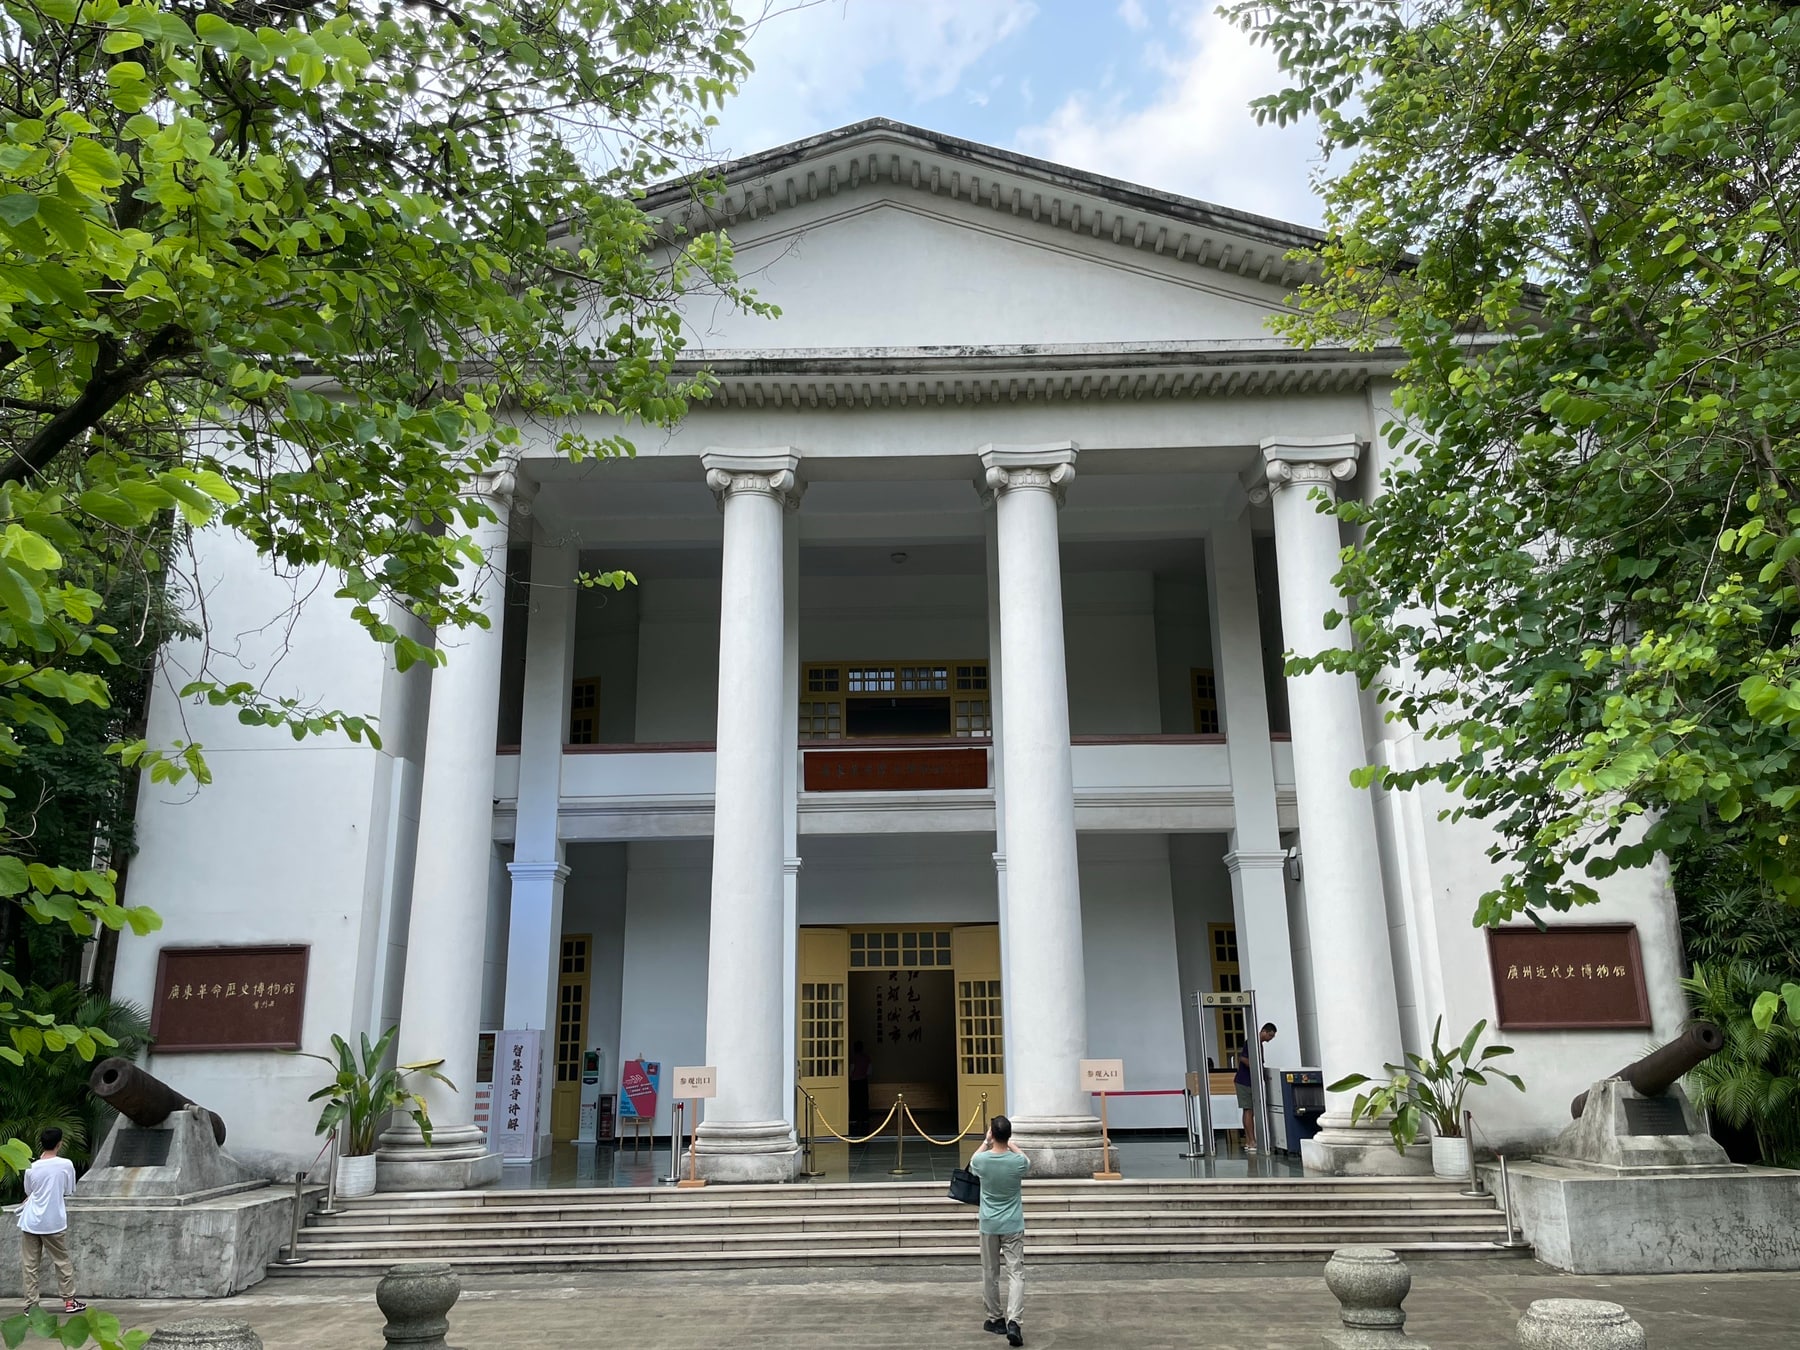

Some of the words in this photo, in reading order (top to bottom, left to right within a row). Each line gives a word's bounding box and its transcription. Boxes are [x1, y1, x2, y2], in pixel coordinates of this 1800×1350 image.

[1507, 963, 1626, 980] 廣州近代史博物館
